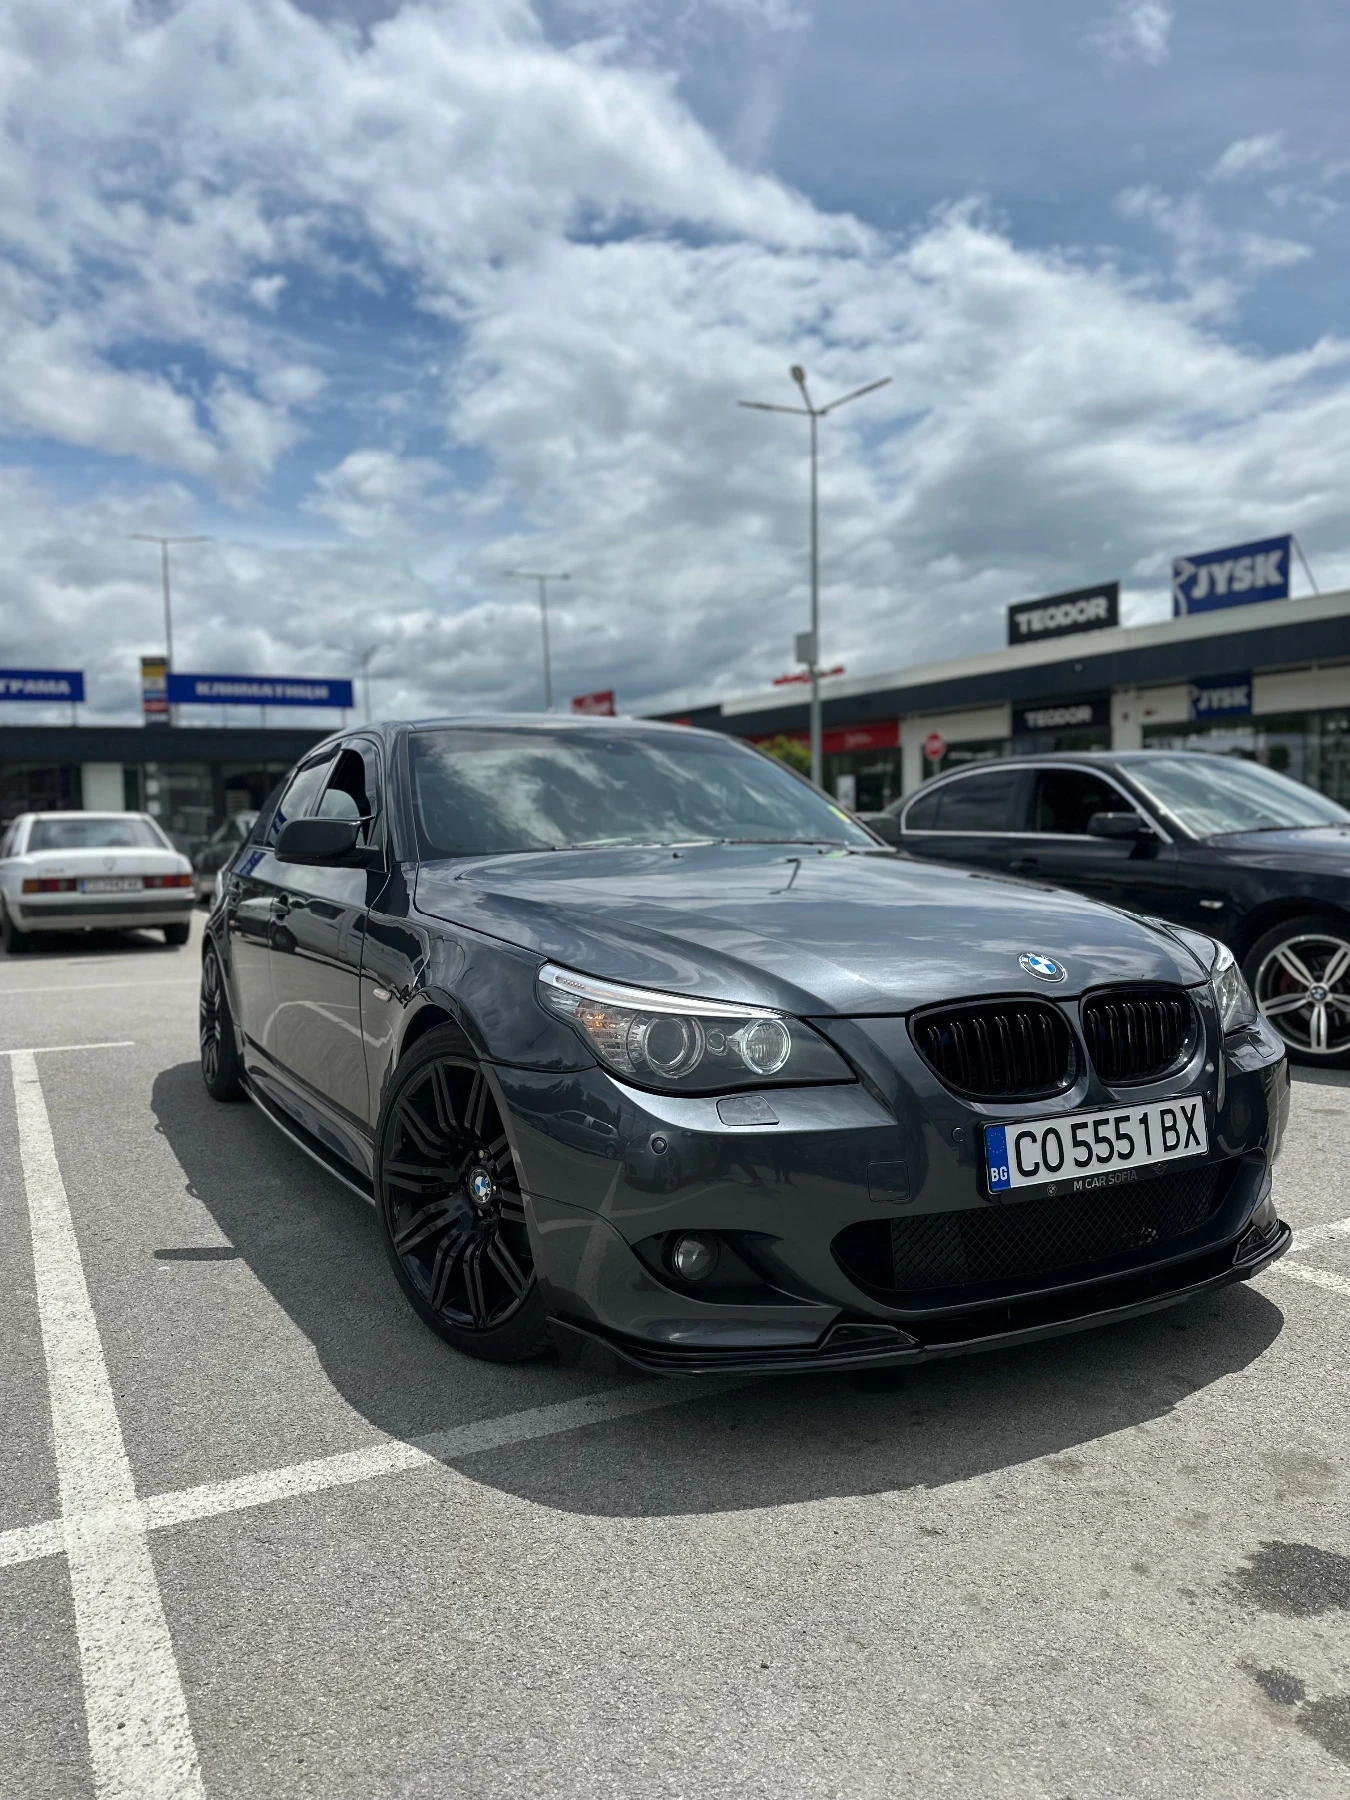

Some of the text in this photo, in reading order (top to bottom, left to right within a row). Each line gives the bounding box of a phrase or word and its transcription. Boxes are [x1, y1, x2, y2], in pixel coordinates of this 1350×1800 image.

[1191, 550, 1285, 599] JYSK
[1014, 596, 1110, 635] TEODOR
[1198, 686, 1250, 712] JYSK
[1024, 705, 1093, 729] TEODOR
[990, 1166, 1008, 1183] BG
[1073, 1169, 1138, 1192] M CAR SOFIA
